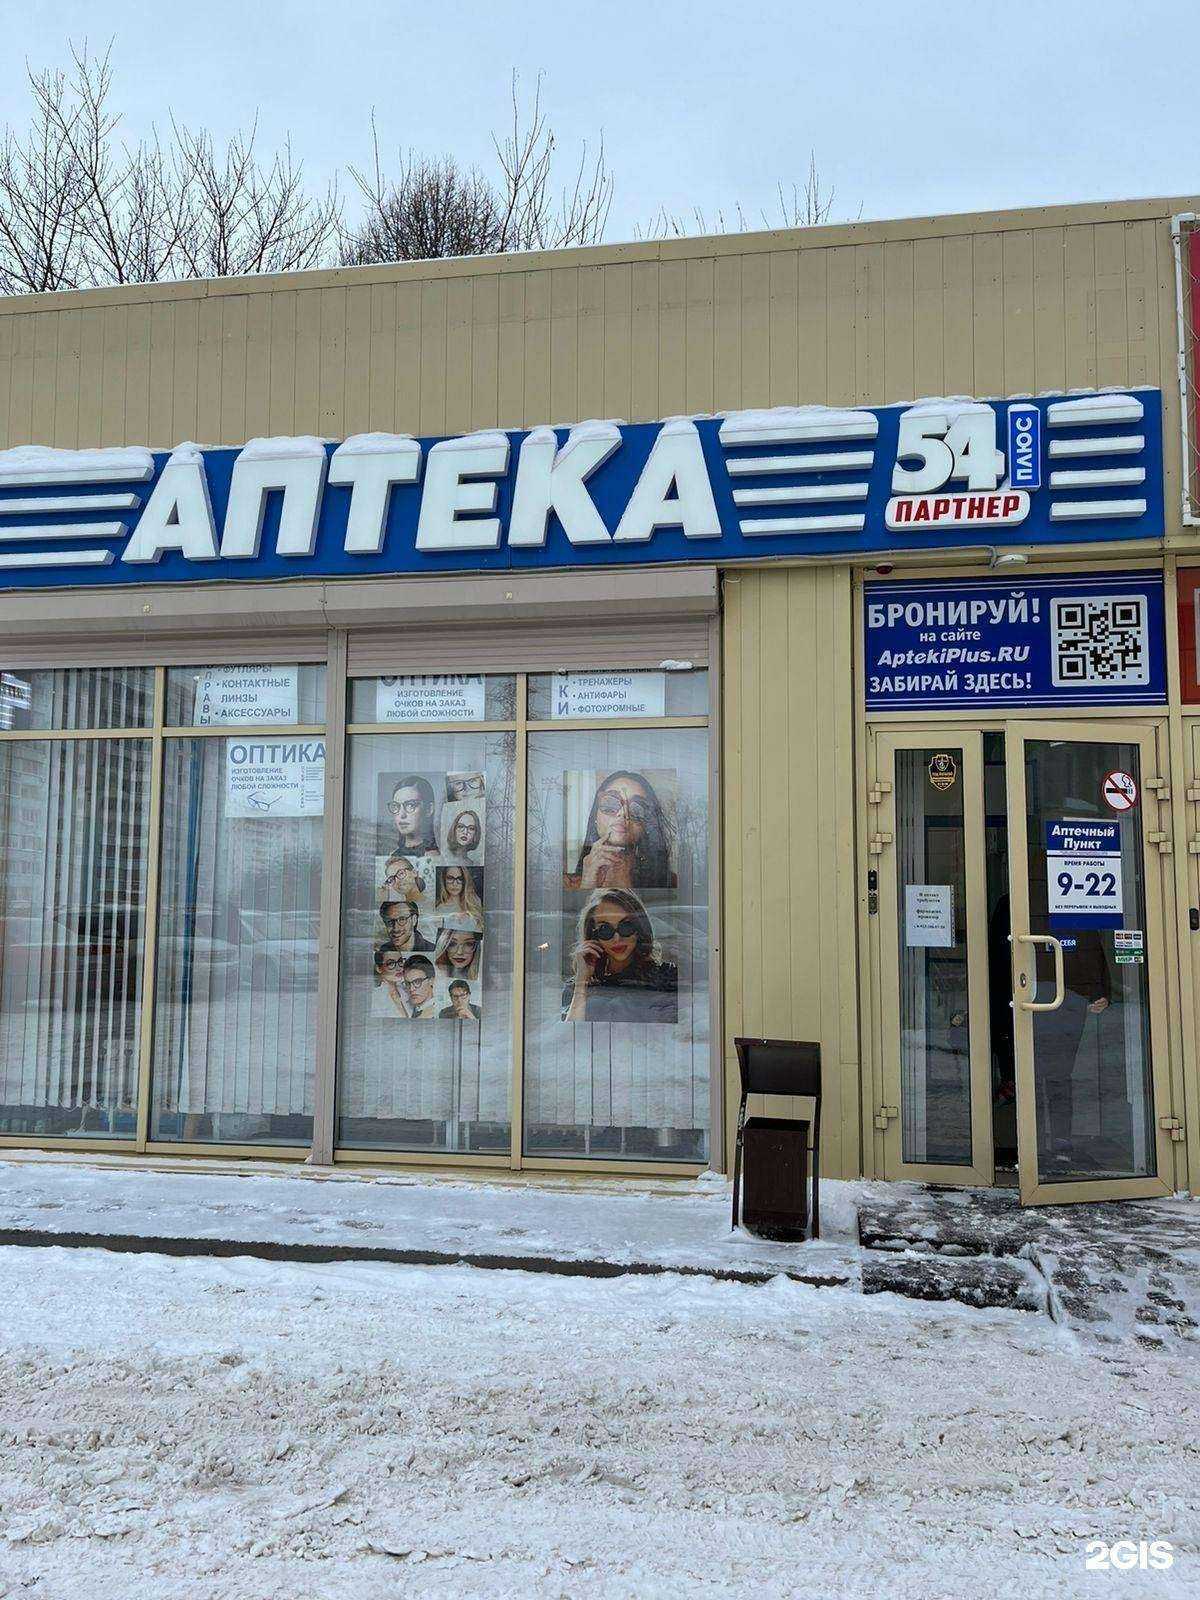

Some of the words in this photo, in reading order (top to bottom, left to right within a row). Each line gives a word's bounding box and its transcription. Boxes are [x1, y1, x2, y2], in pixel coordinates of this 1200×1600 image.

[891, 401, 1006, 494] 54
[1015, 416, 1033, 481] ПЛЮС
[121, 420, 722, 564] АПТЕКА
[894, 495, 1021, 523] ПАРТНЕР
[867, 591, 1041, 628] БРОНИРУЙ!
[919, 632, 937, 642] на
[940, 628, 982, 642] сайте
[877, 645, 1031, 669] AptekiPlus.RU
[221, 679, 290, 688] КОНТАКТНЫЕ
[578, 679, 632, 687] ТРЕНАЖЕРЫ
[869, 669, 959, 693] ЗАБИРАЙ
[963, 672, 1032, 693] ЗДЕСЬ!
[220, 694, 258, 703] ЛИНЗЫ
[396, 689, 464, 698] ИЗГОТОВЛЕНИЕ
[577, 691, 627, 699] АНТИФАРЫ
[394, 700, 424, 708] ОЧКОВ
[425, 700, 437, 708] НА
[439, 699, 466, 707] ЗАКАЗ
[577, 704, 646, 713] ФОТОХРОМНЫЕ
[220, 708, 292, 718] АКСЕССУАРЫ
[386, 709, 419, 718] ЛЮБОЙ
[420, 709, 475, 717] СЛОЖНОСТИ
[229, 742, 326, 765] ОПТИКА
[1051, 824, 1115, 837] Аптечный
[1063, 837, 1101, 851] Пункт
[1057, 872, 1117, 897] 9-22
